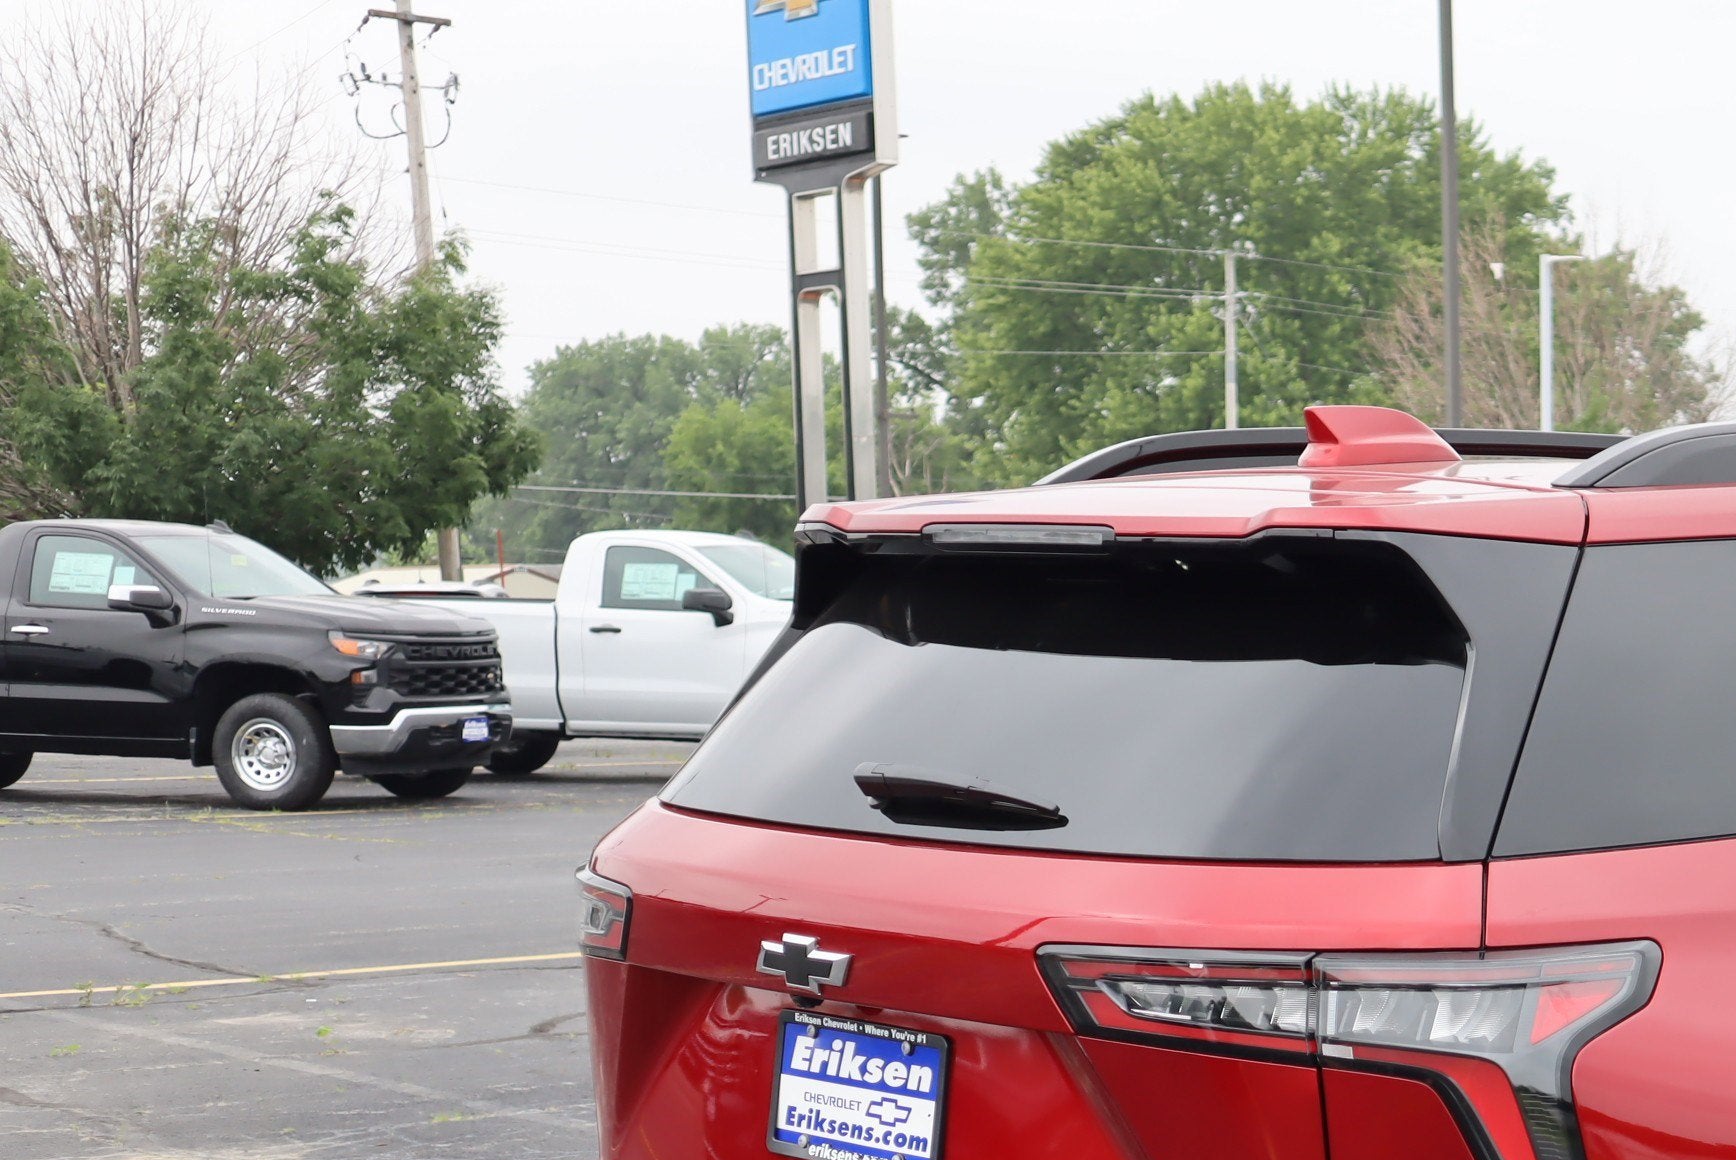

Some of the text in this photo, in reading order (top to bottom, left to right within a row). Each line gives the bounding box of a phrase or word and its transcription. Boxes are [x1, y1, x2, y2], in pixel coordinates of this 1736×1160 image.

[753, 44, 856, 91] CHEVROLET
[766, 121, 853, 160] ERIKSEN
[794, 1012, 821, 1026] Eriksen
[822, 1017, 857, 1032] Chevrolet
[864, 1024, 889, 1037] Where
[790, 1035, 933, 1093] Eriksen
[803, 1091, 862, 1111] CHEVROLET
[785, 1105, 928, 1153] Eriksens.com
